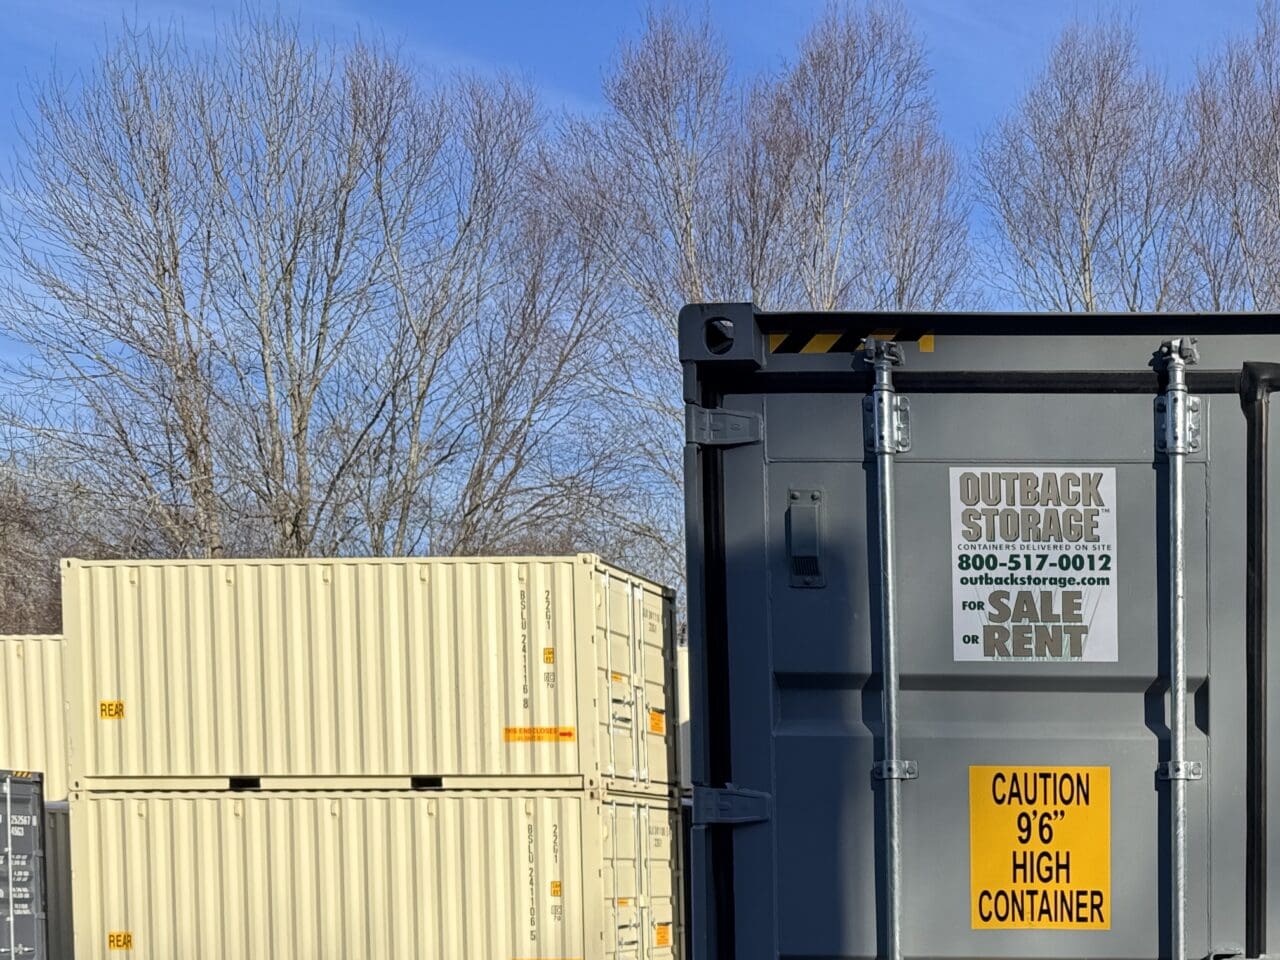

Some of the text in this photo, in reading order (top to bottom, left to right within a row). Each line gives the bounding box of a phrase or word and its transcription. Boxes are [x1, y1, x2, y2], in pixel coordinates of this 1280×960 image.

[959, 472, 1105, 506] OUTBACK
[961, 508, 1100, 542] STORAGE
[957, 543, 1112, 551] CONTAINERS DELIVERED ON SITE
[957, 553, 1111, 571] 800-517-0012
[960, 573, 1110, 588] outbackstorage.com
[962, 590, 1083, 623] FOR SALE
[962, 624, 1089, 658] OR RENT
[100, 703, 124, 717] REAR
[992, 772, 1090, 806] CAUTION
[1012, 851, 1071, 884] HIGH
[978, 889, 1105, 923] CONTAINER
[109, 934, 132, 948] REAR
